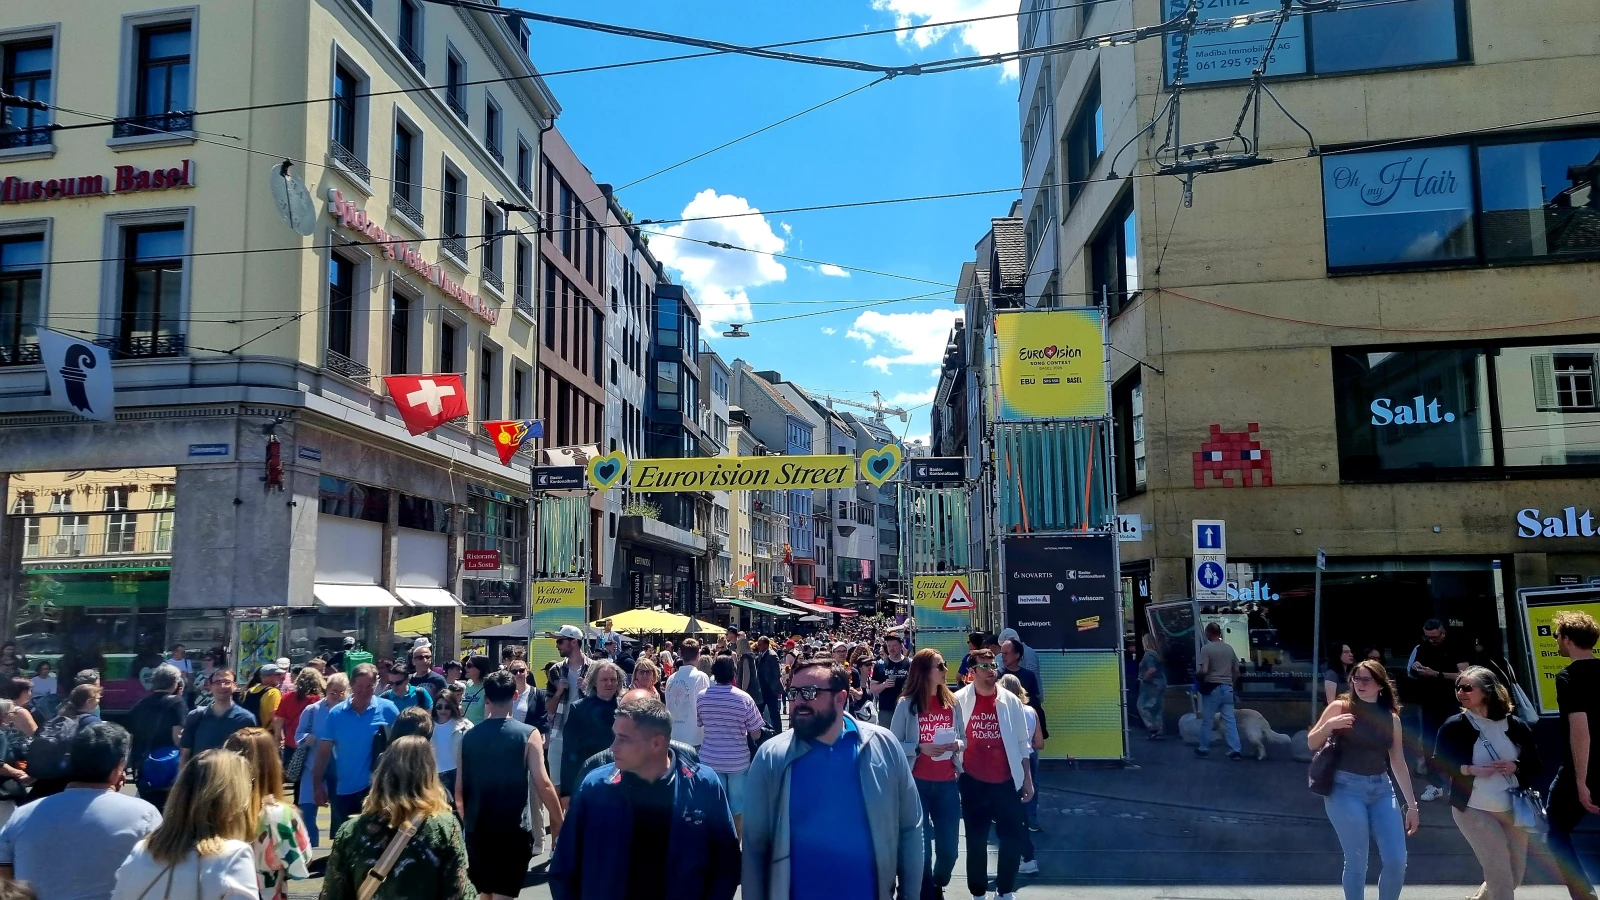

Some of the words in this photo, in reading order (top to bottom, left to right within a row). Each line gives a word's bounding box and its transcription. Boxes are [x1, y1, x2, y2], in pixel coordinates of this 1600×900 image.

[1195, 49, 1227, 58] Madiba
[1196, 61, 1216, 71] 061
[1220, 58, 1241, 69] 295
[113, 159, 195, 193] Basel
[1333, 166, 1361, 190] Oh
[1361, 156, 1459, 206] Hair
[1020, 378, 1036, 386] EBU
[1370, 394, 1456, 426] Salt.
[633, 462, 771, 489] Eurovision
[774, 461, 850, 486] Street
[537, 585, 576, 595] Welcome
[916, 580, 947, 589] United
[1226, 580, 1280, 601] Salt.
[535, 595, 562, 605] Home
[916, 590, 930, 601] By
[930, 590, 949, 599] Mus
